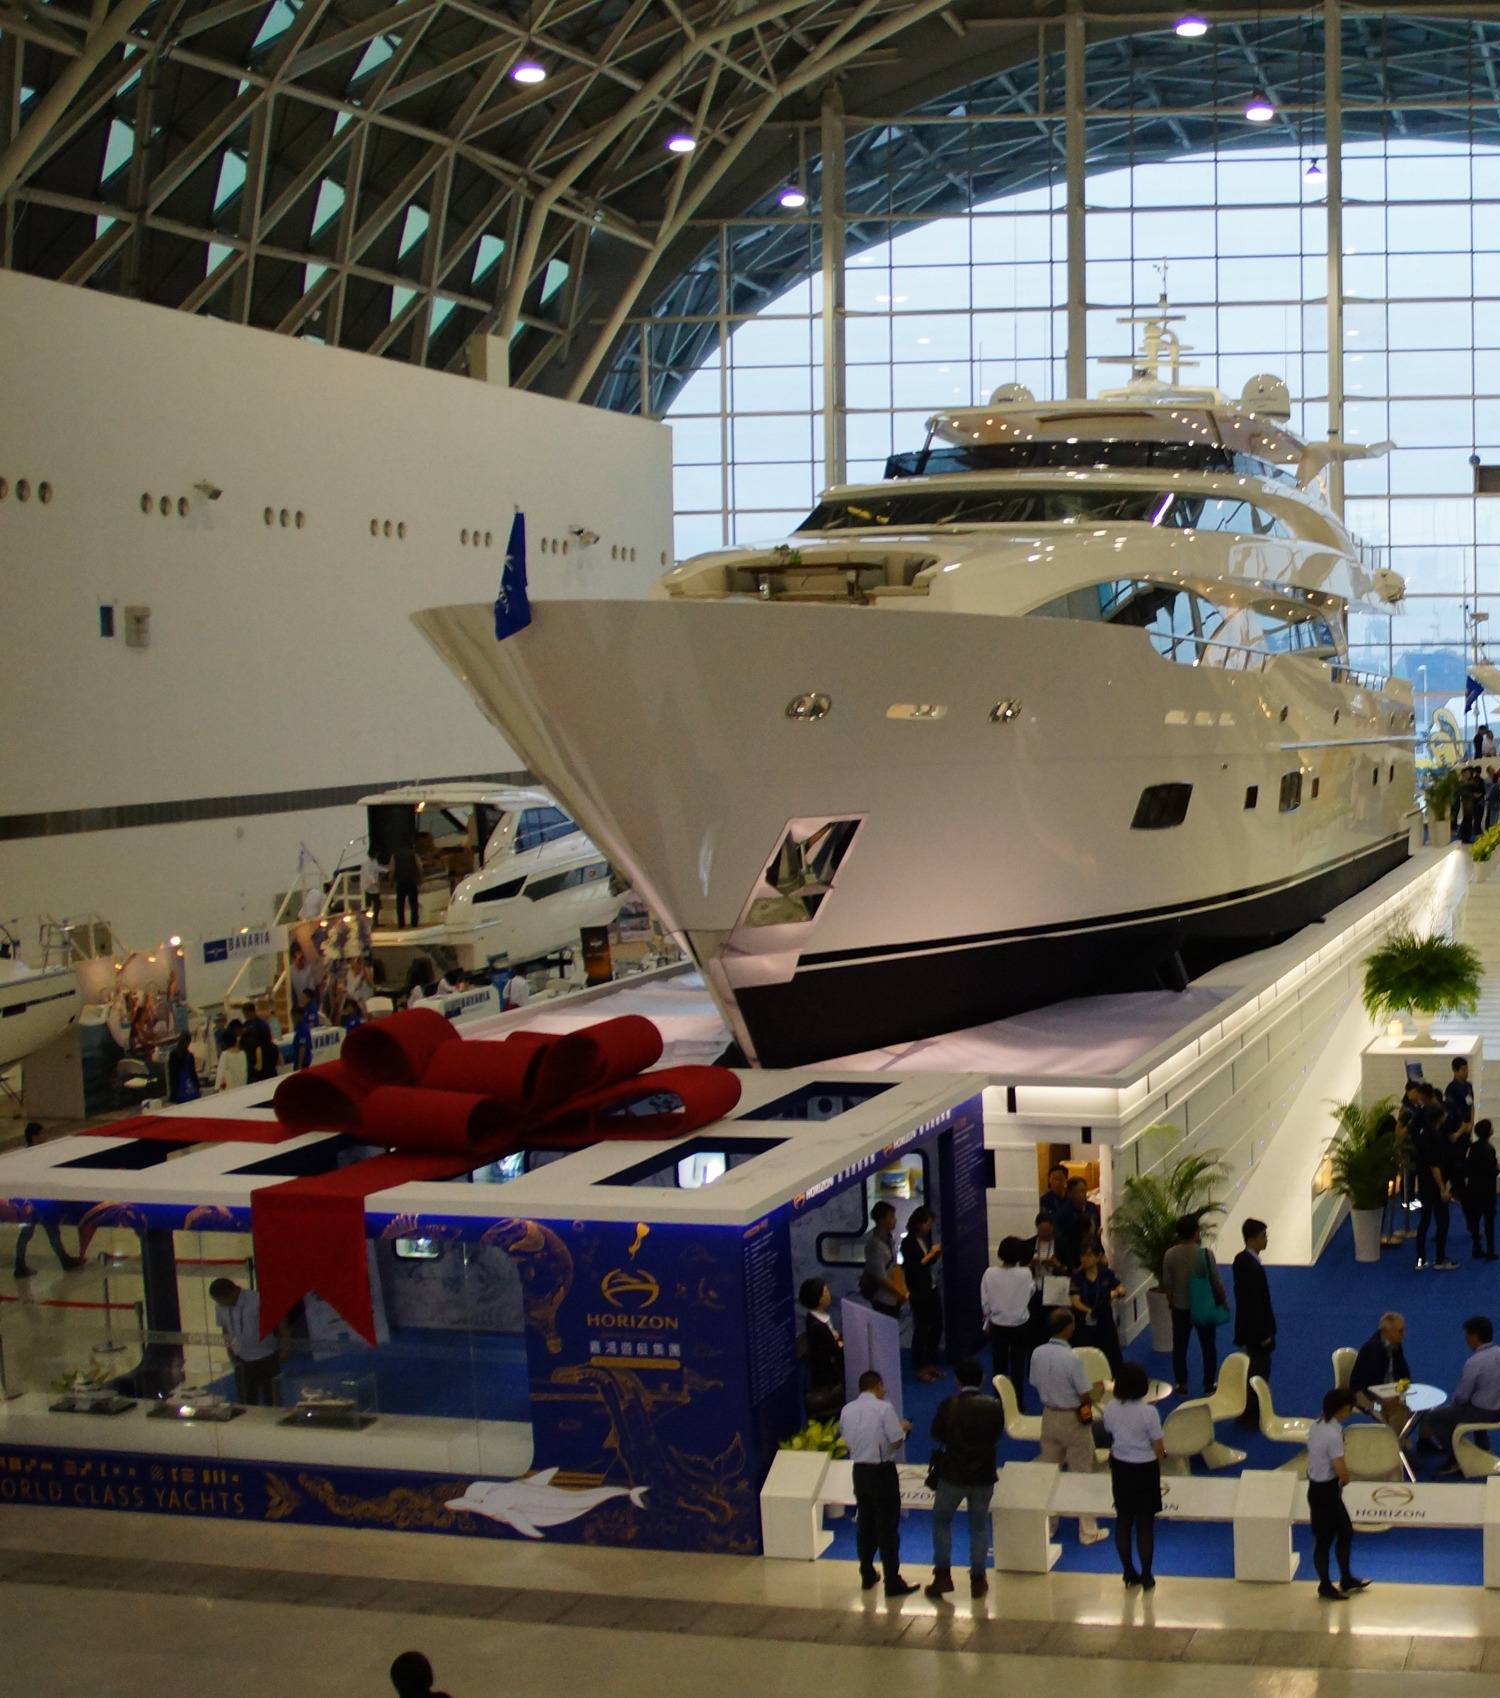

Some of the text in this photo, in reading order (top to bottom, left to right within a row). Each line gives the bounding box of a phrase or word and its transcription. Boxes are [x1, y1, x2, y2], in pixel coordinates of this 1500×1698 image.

[228, 931, 270, 951] BAVARIA
[586, 1313, 679, 1330] HORIZON
[0, 1477, 245, 1515] ORLD CLASS YACHTS
[1355, 1509, 1426, 1519] HORIZON
